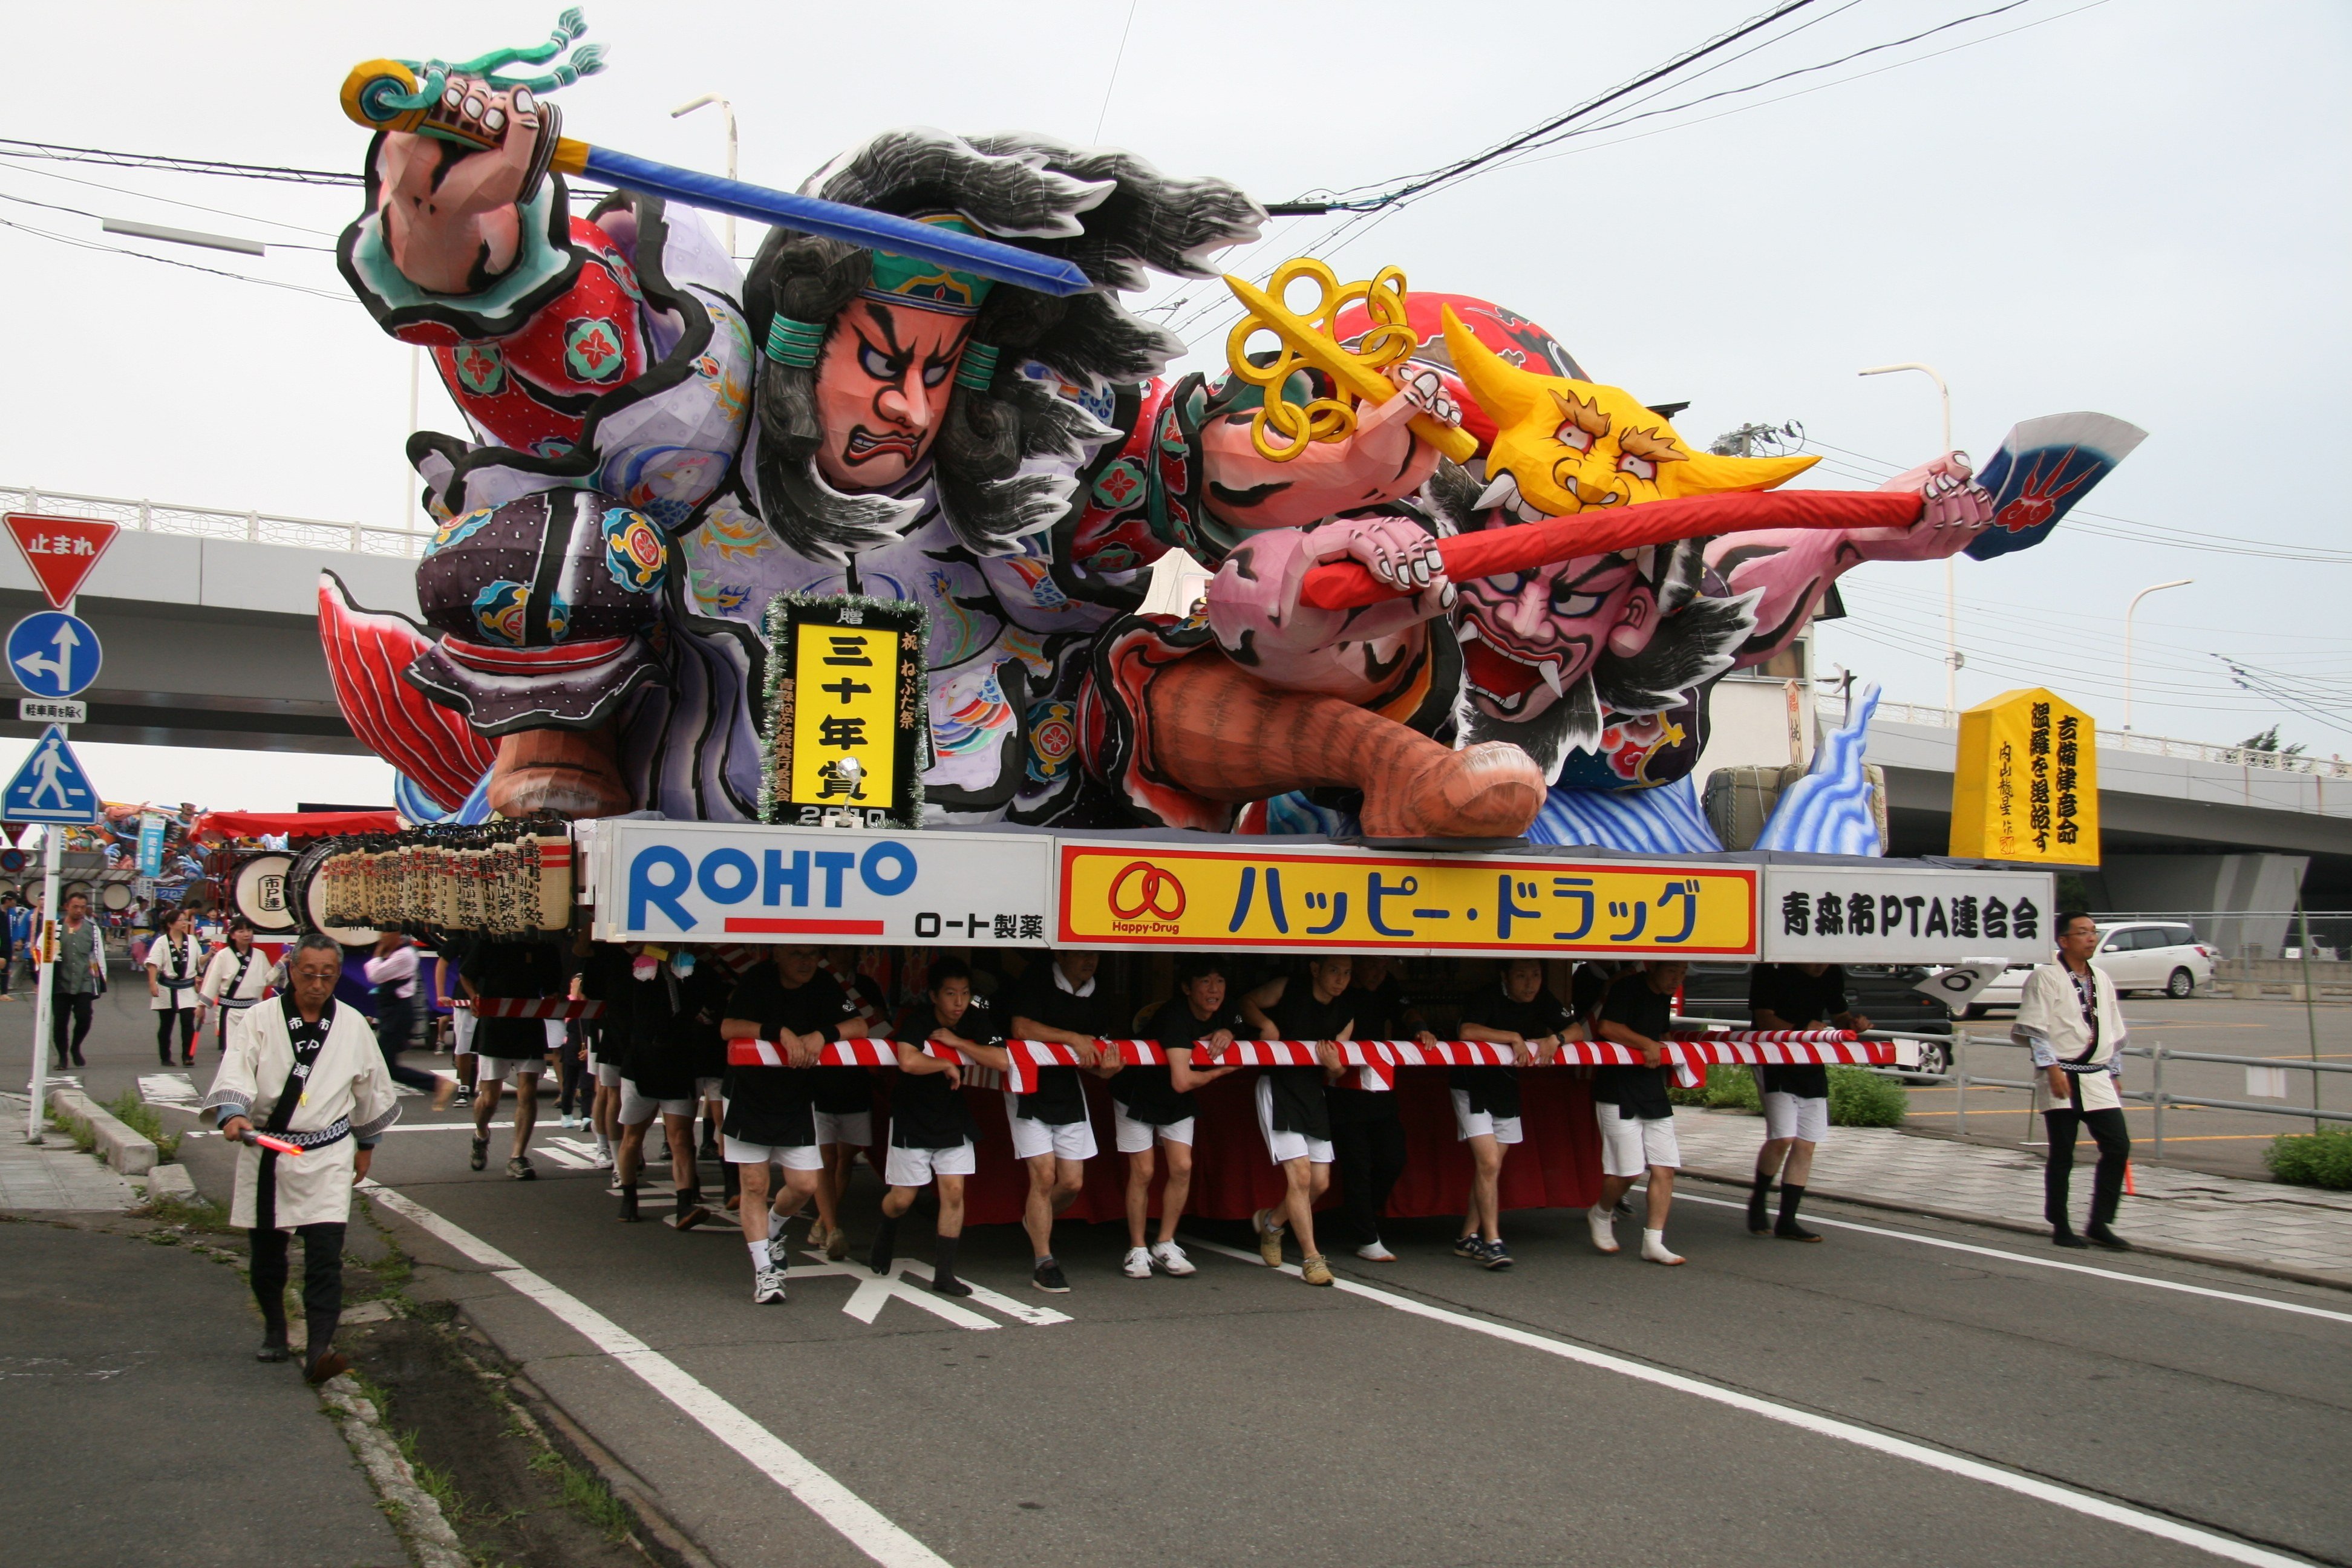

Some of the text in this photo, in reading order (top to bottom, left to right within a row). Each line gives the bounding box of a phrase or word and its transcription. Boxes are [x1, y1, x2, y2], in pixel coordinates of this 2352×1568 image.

[28, 534, 95, 556] 止まれ
[837, 607, 863, 625] 贈
[25, 704, 82, 718] 軽車両を除く
[899, 632, 918, 730] 祝 ねぶた祭
[815, 635, 873, 801] 三十年賞
[2056, 714, 2079, 845] 吉備津彦命
[627, 841, 918, 932] ROHTO
[1228, 866, 1700, 943] ハッピー・ドラッグ
[1782, 890, 2039, 940] 青森市PTA連合会
[915, 912, 1043, 939] ロート製薬
